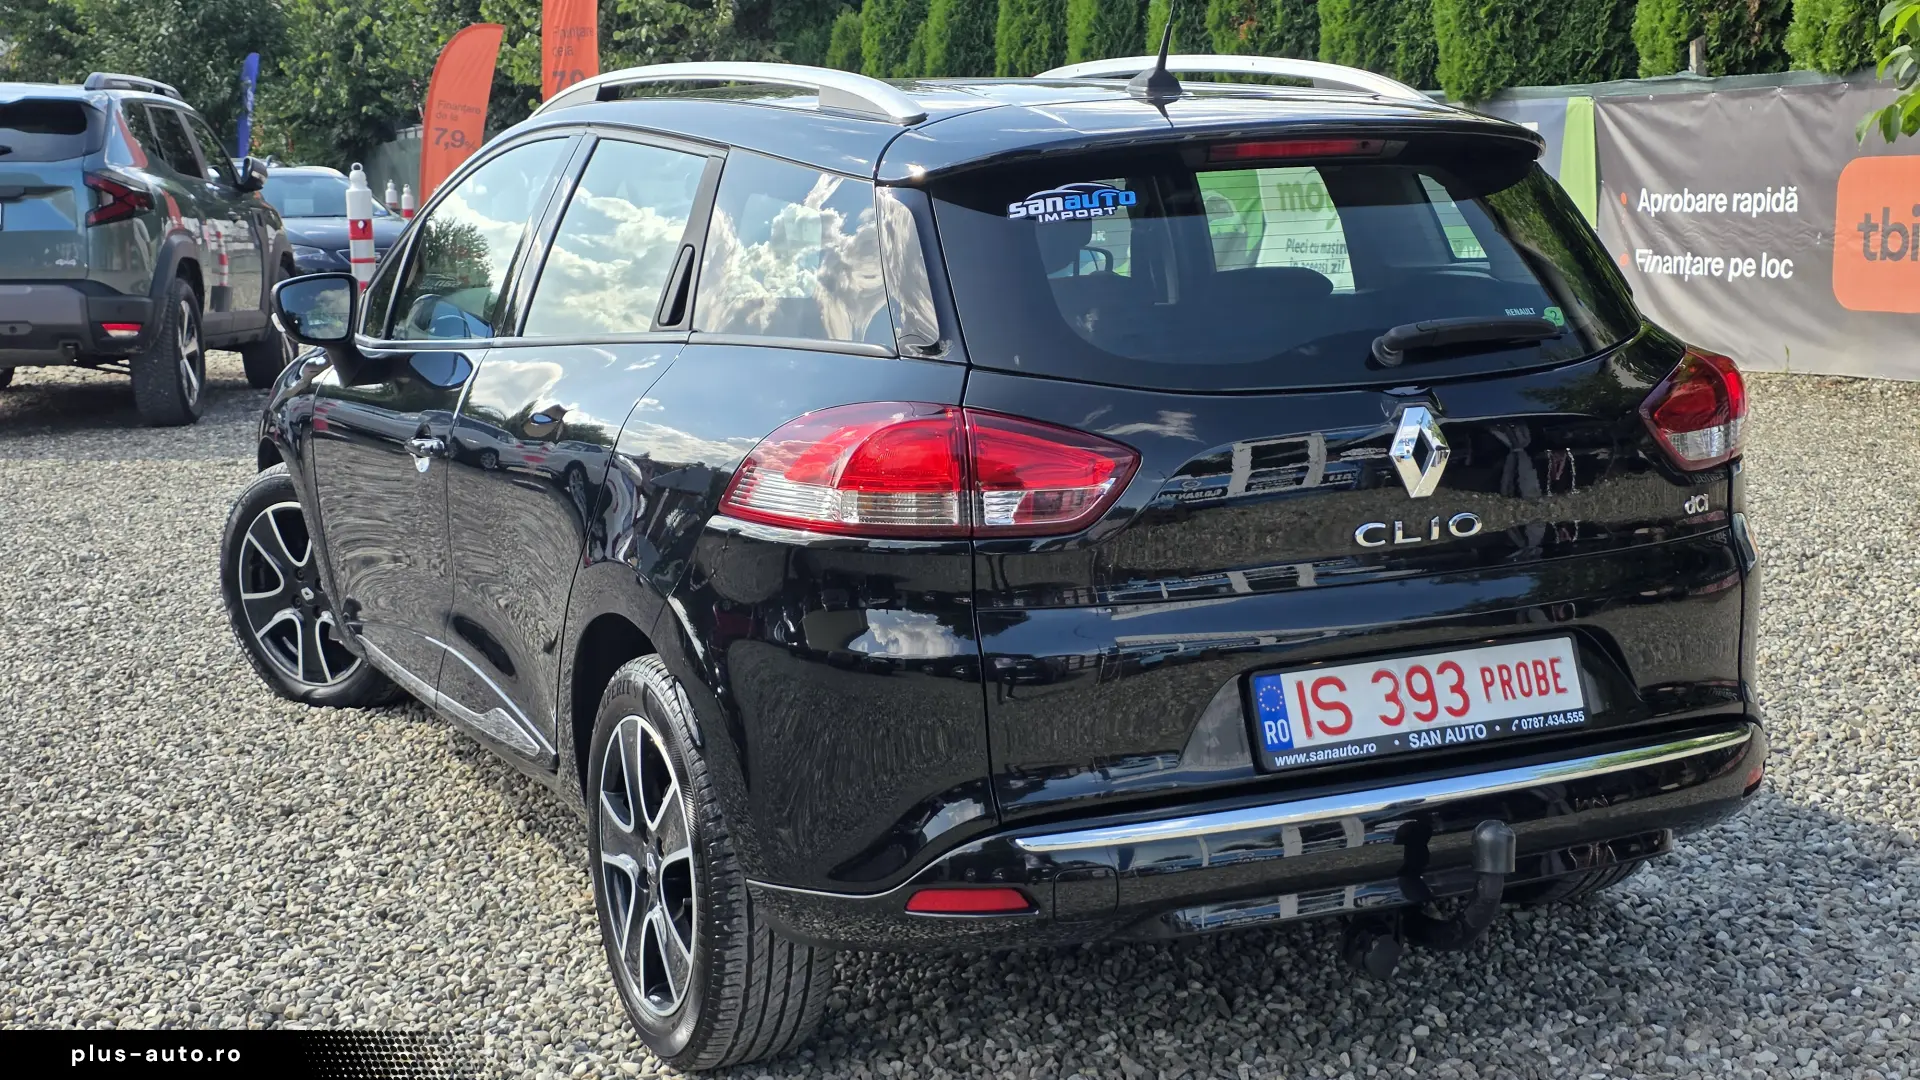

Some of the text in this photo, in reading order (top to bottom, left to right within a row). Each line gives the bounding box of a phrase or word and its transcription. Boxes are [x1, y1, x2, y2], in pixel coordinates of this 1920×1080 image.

[1038, 207, 1117, 223] IMPORT
[1637, 186, 1799, 217] Aprobare rapidă
[1331, 259, 1346, 274] zi!
[1635, 249, 1794, 283] Finanțare pe loc
[1505, 307, 1536, 317] RENAULT
[1355, 512, 1483, 548] CLIO
[1296, 656, 1569, 740] IS 393 PROBE
[1264, 718, 1290, 745] RO
[1275, 710, 1585, 767] www.sanauto.ro SAN AUTO 0787.434.555
